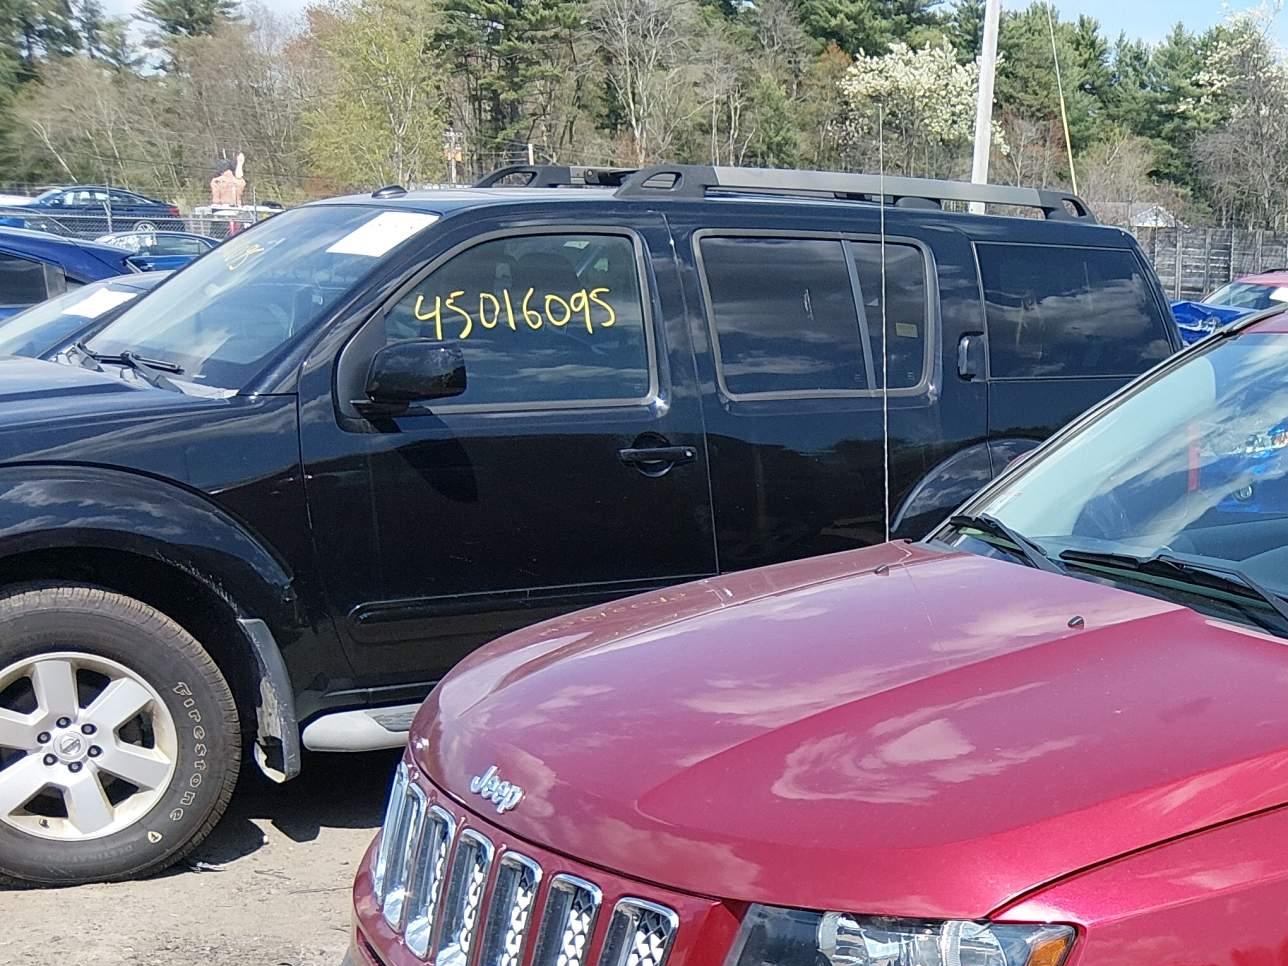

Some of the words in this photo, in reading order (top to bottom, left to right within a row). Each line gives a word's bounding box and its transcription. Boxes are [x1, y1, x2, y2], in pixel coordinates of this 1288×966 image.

[414, 287, 616, 341] 45016095
[169, 681, 208, 822] Firestone
[470, 765, 524, 814] Jeep
